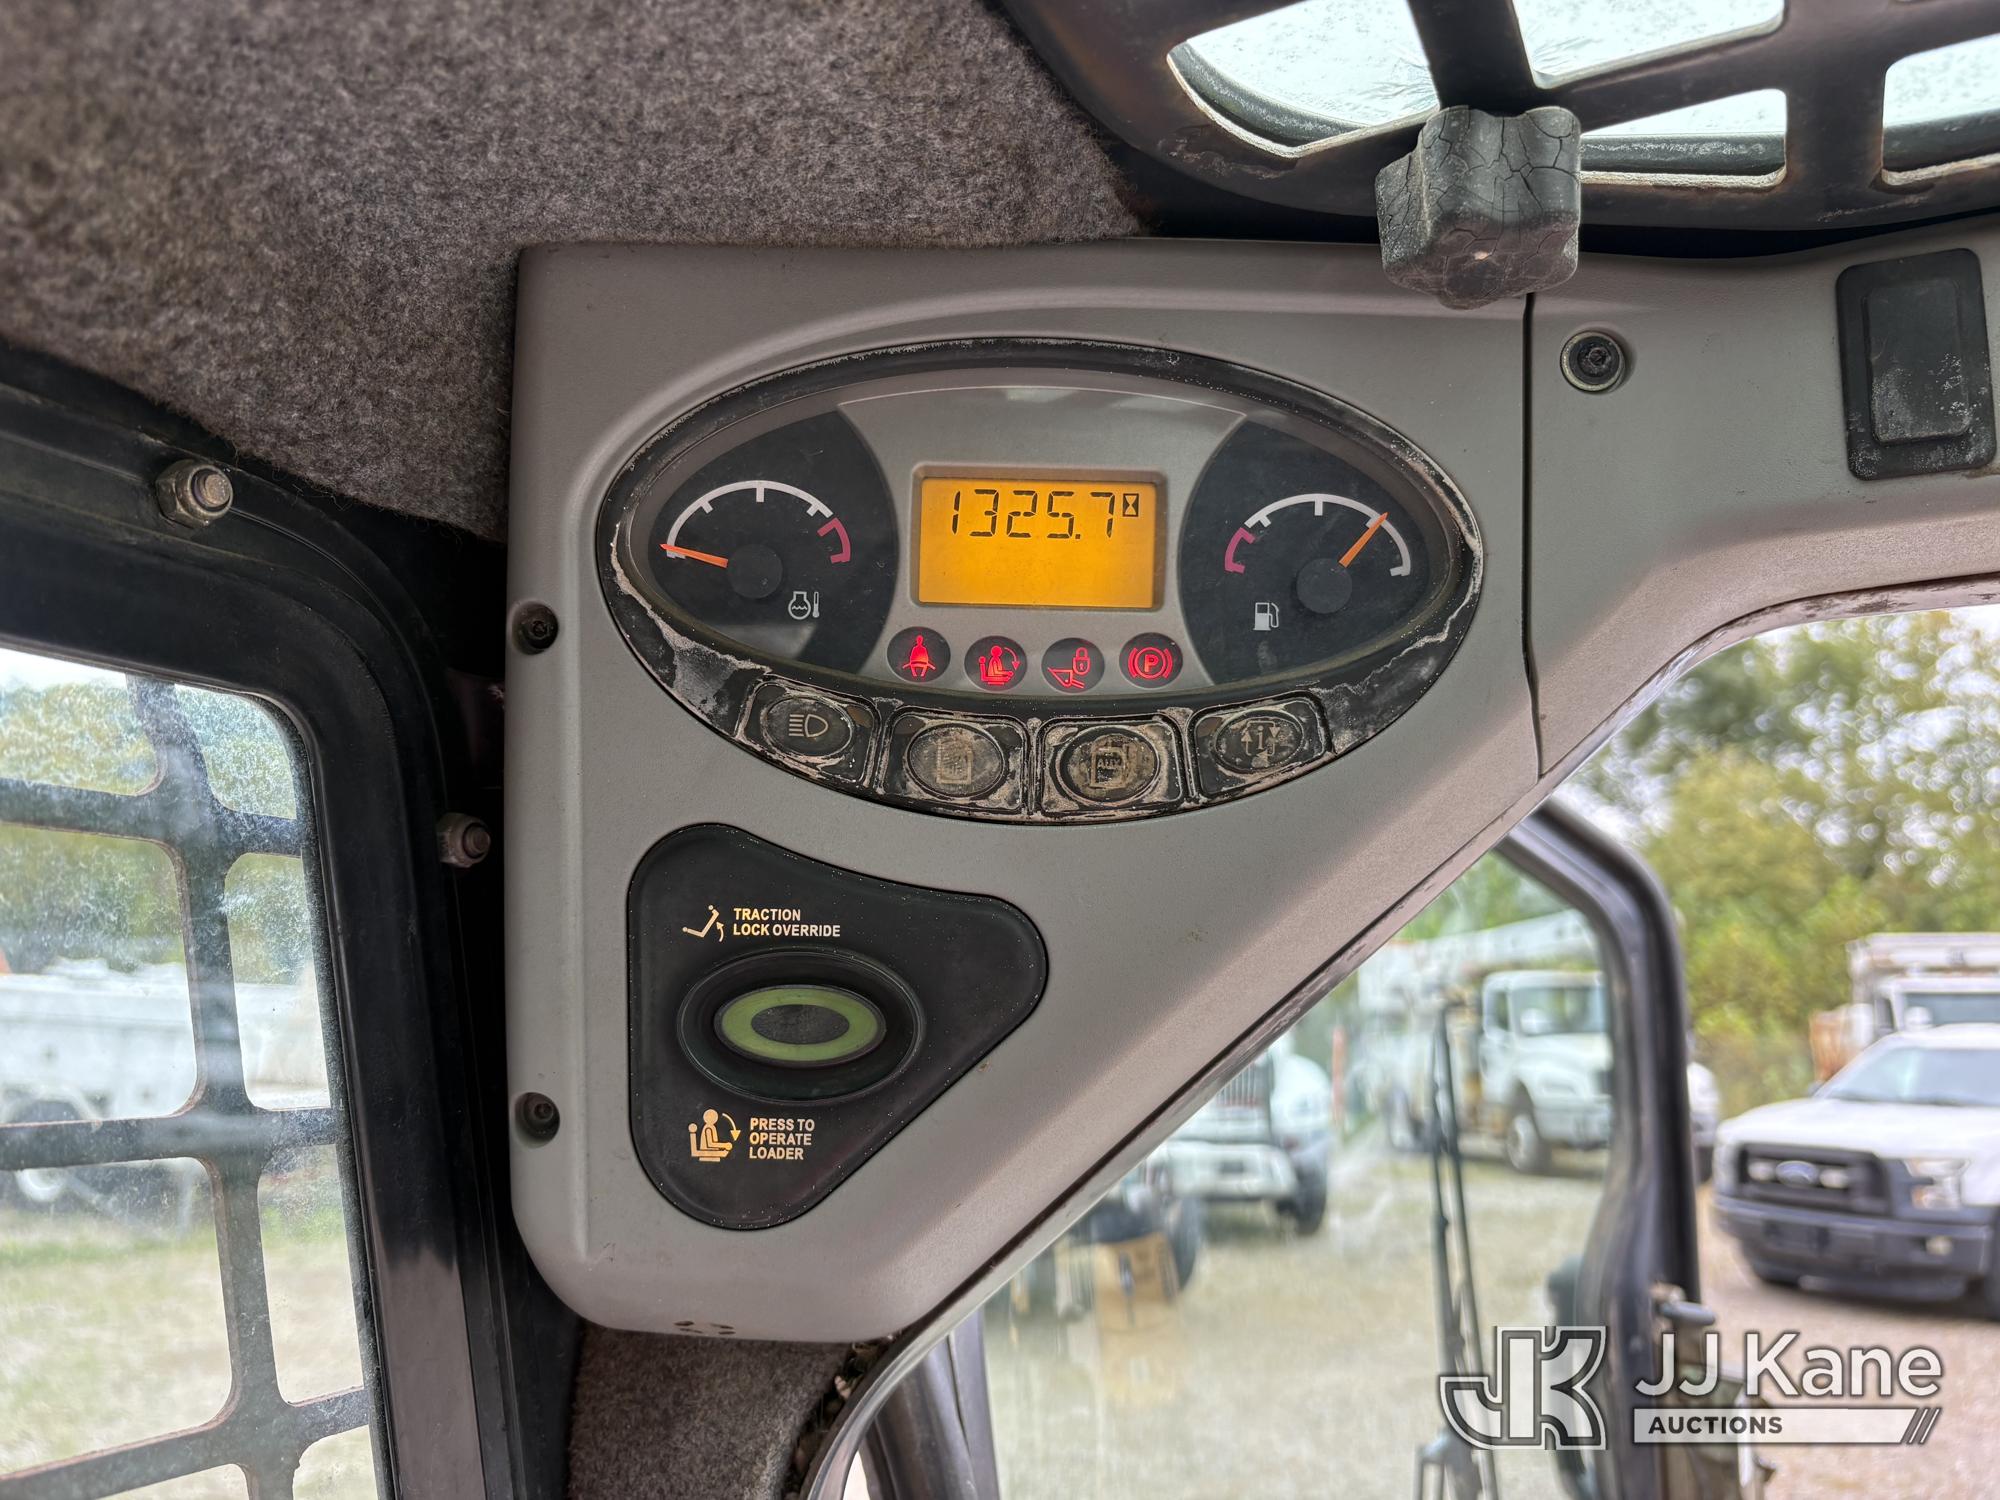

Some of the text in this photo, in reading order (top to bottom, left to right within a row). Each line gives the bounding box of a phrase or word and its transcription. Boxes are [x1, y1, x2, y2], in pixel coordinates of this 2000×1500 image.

[951, 488, 1116, 540] 1325.7
[1144, 653, 1159, 673] P
[733, 907, 801, 921] TRACTION
[733, 923, 841, 937] LOCK OVERRIDE
[750, 1117, 815, 1132] PRESS TO
[749, 1132, 812, 1146] OPERATE
[749, 1146, 804, 1160] LOADER
